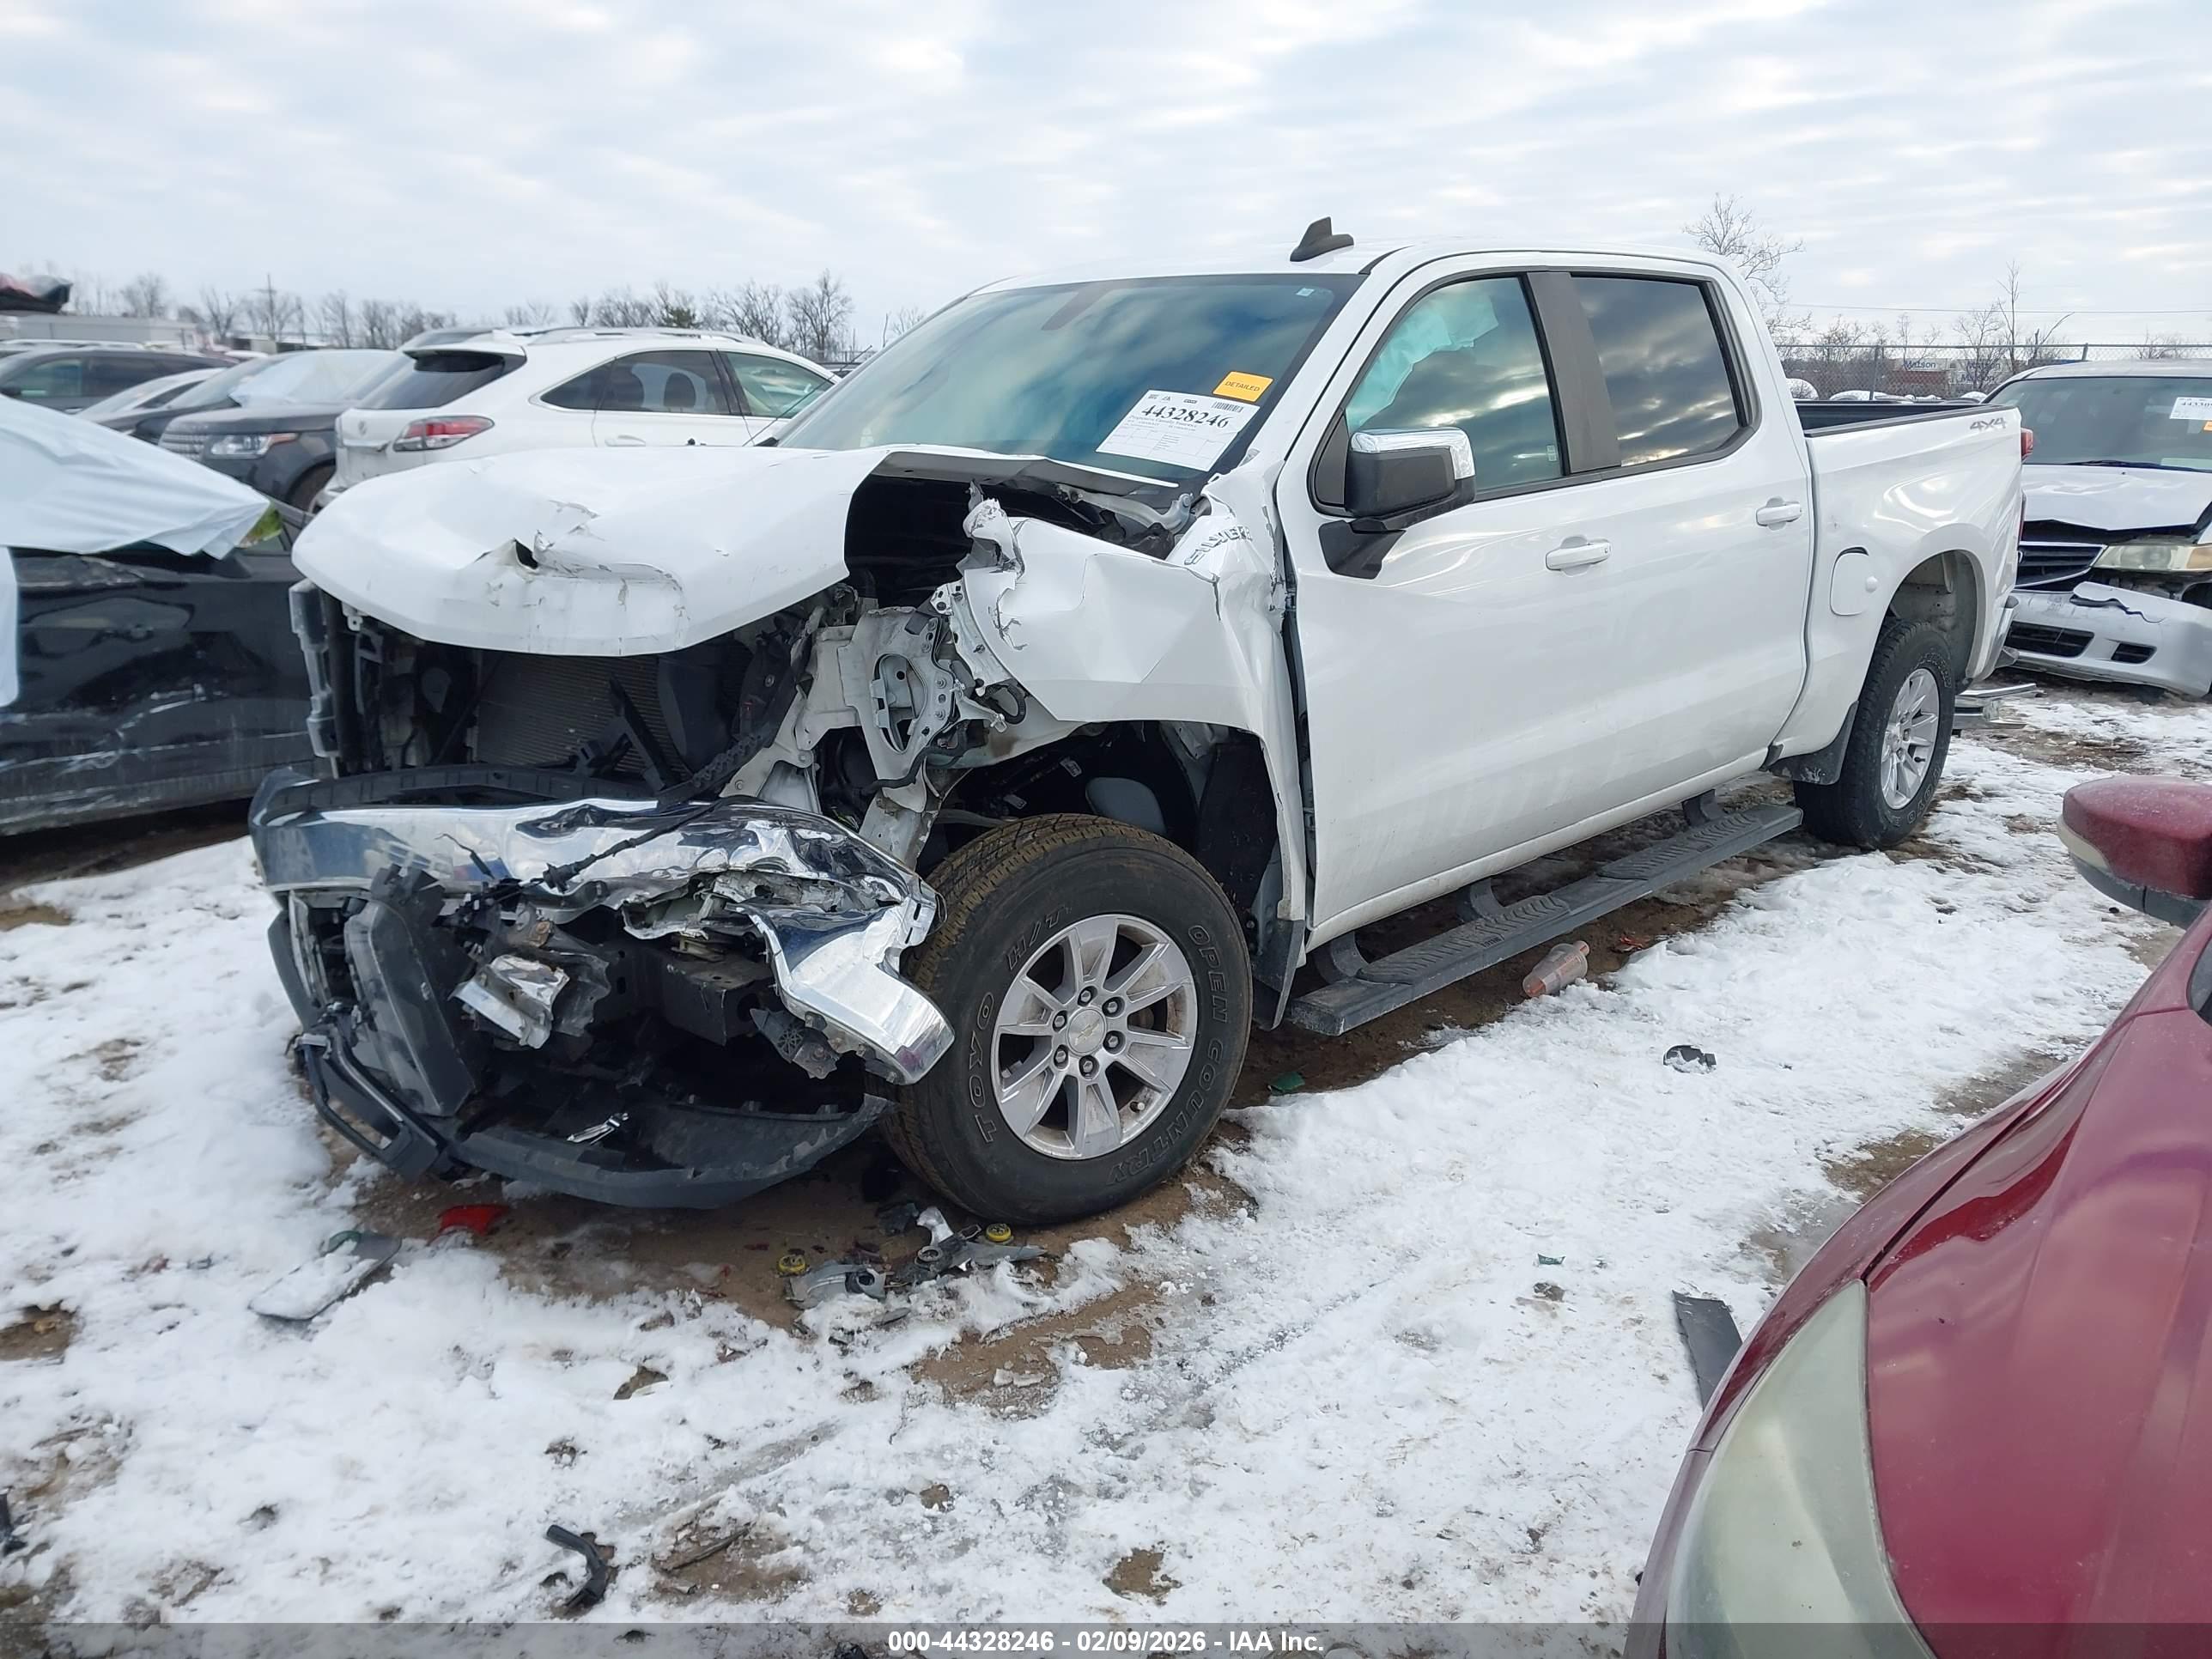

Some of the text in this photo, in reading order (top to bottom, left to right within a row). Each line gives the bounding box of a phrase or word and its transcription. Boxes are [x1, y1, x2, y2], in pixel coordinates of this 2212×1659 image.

[1141, 404, 1234, 428] 44328246
[1224, 380, 1261, 392] DETAILED
[969, 991, 997, 1144] TOYO
[1105, 924, 1228, 1186] OPEN COUNTRY
